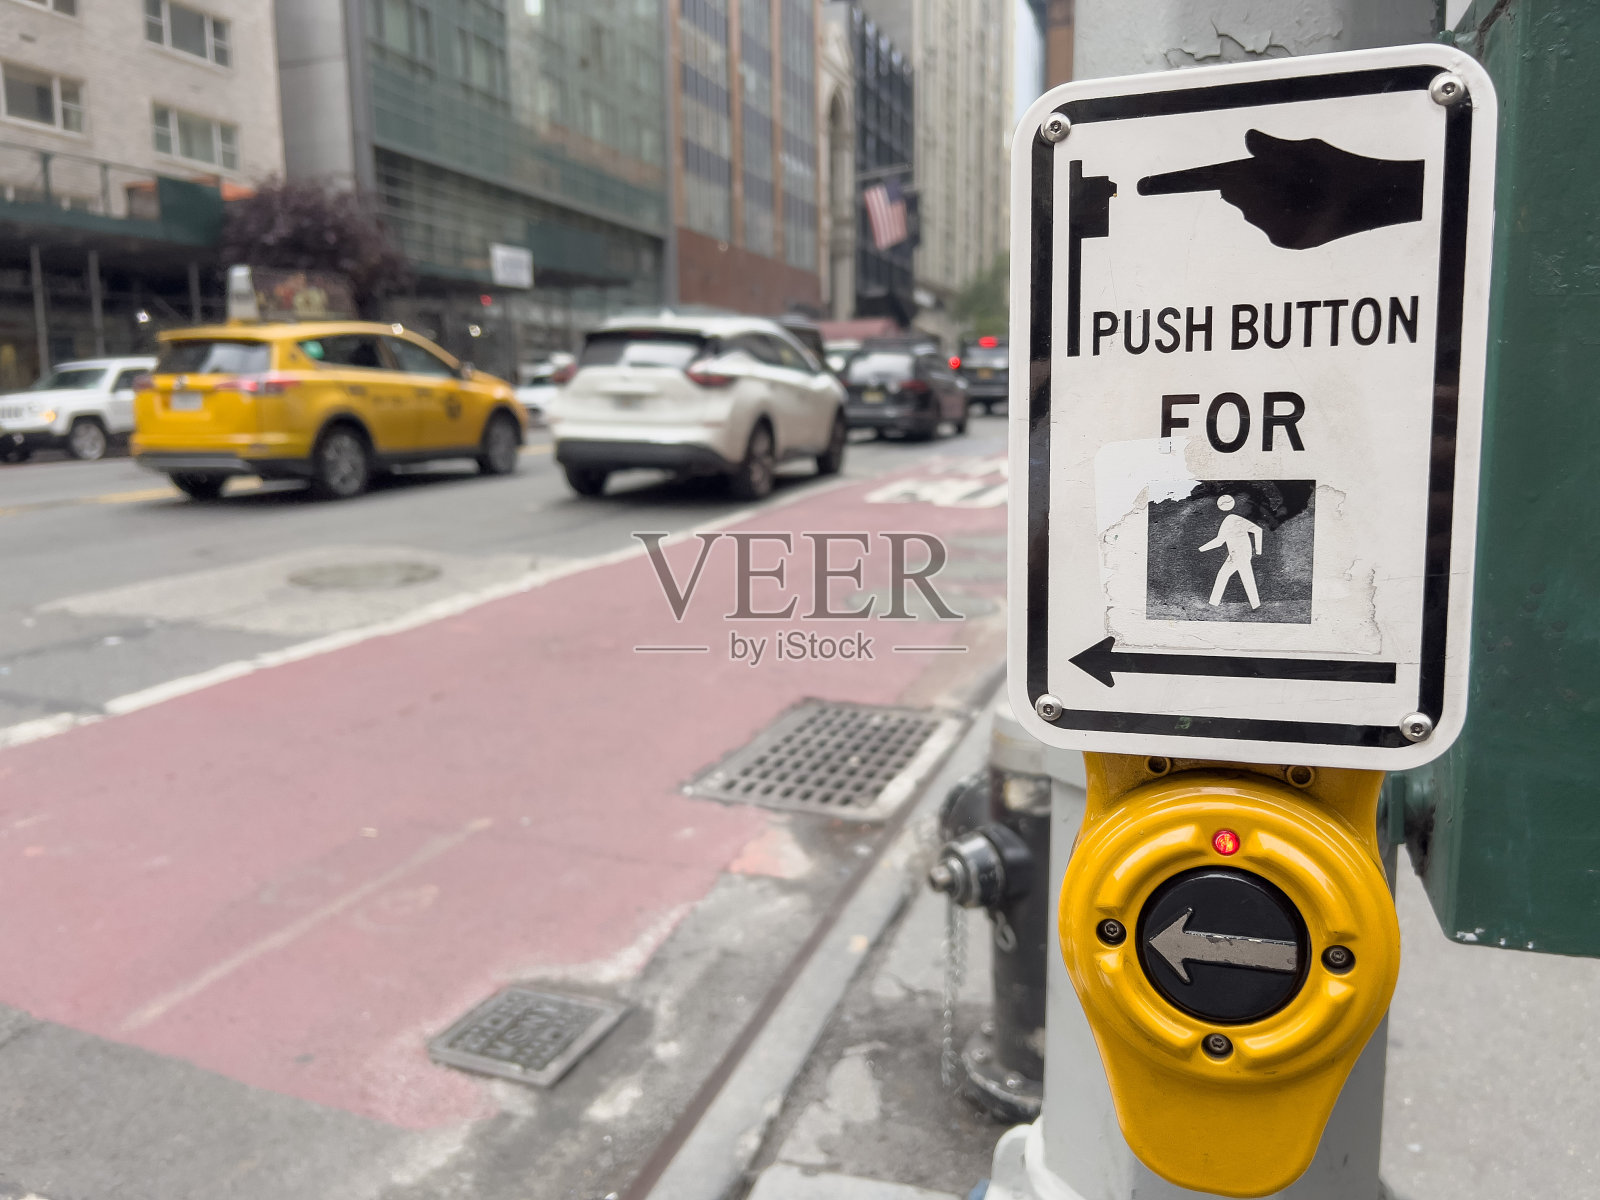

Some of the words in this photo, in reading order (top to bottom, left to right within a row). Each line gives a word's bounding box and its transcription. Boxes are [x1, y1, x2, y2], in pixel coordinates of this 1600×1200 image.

[1092, 305, 1213, 356] PUSH
[1230, 295, 1419, 351] BUTTON
[1160, 391, 1306, 454] FOR
